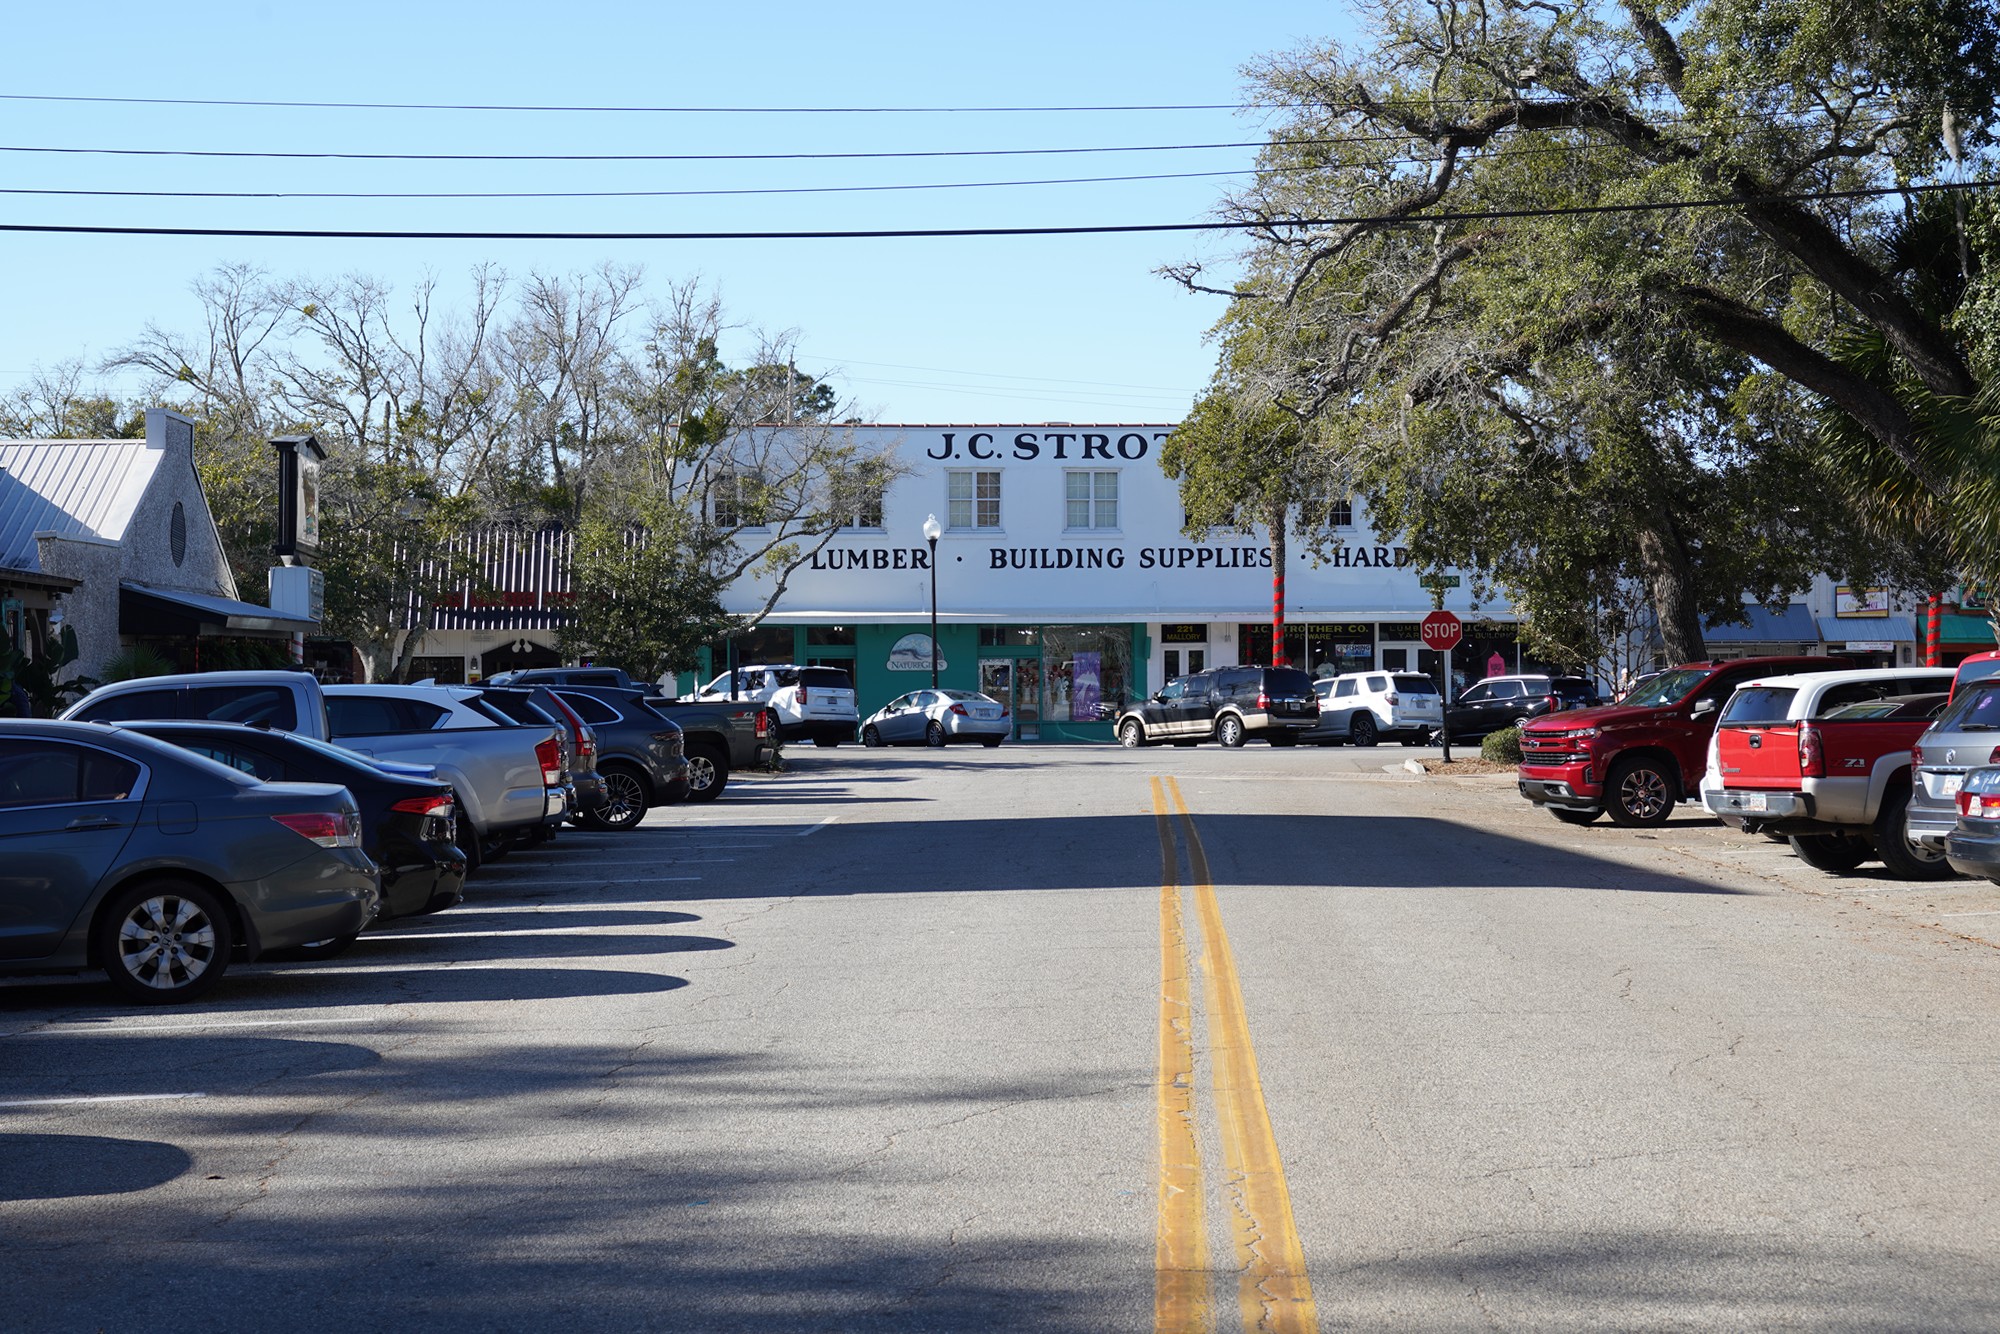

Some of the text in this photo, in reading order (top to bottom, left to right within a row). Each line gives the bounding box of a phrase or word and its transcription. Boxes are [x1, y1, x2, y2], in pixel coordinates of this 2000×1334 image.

[1012, 433, 1171, 461] STRO
[810, 548, 932, 570] LUMBER
[989, 547, 1125, 569] BUILDING
[1139, 547, 1273, 569] SUPPLIES
[1176, 625, 1193, 633] 221
[1284, 625, 1342, 633] TROTHER
[1347, 625, 1369, 633] CO.
[1424, 623, 1459, 638] STOP
